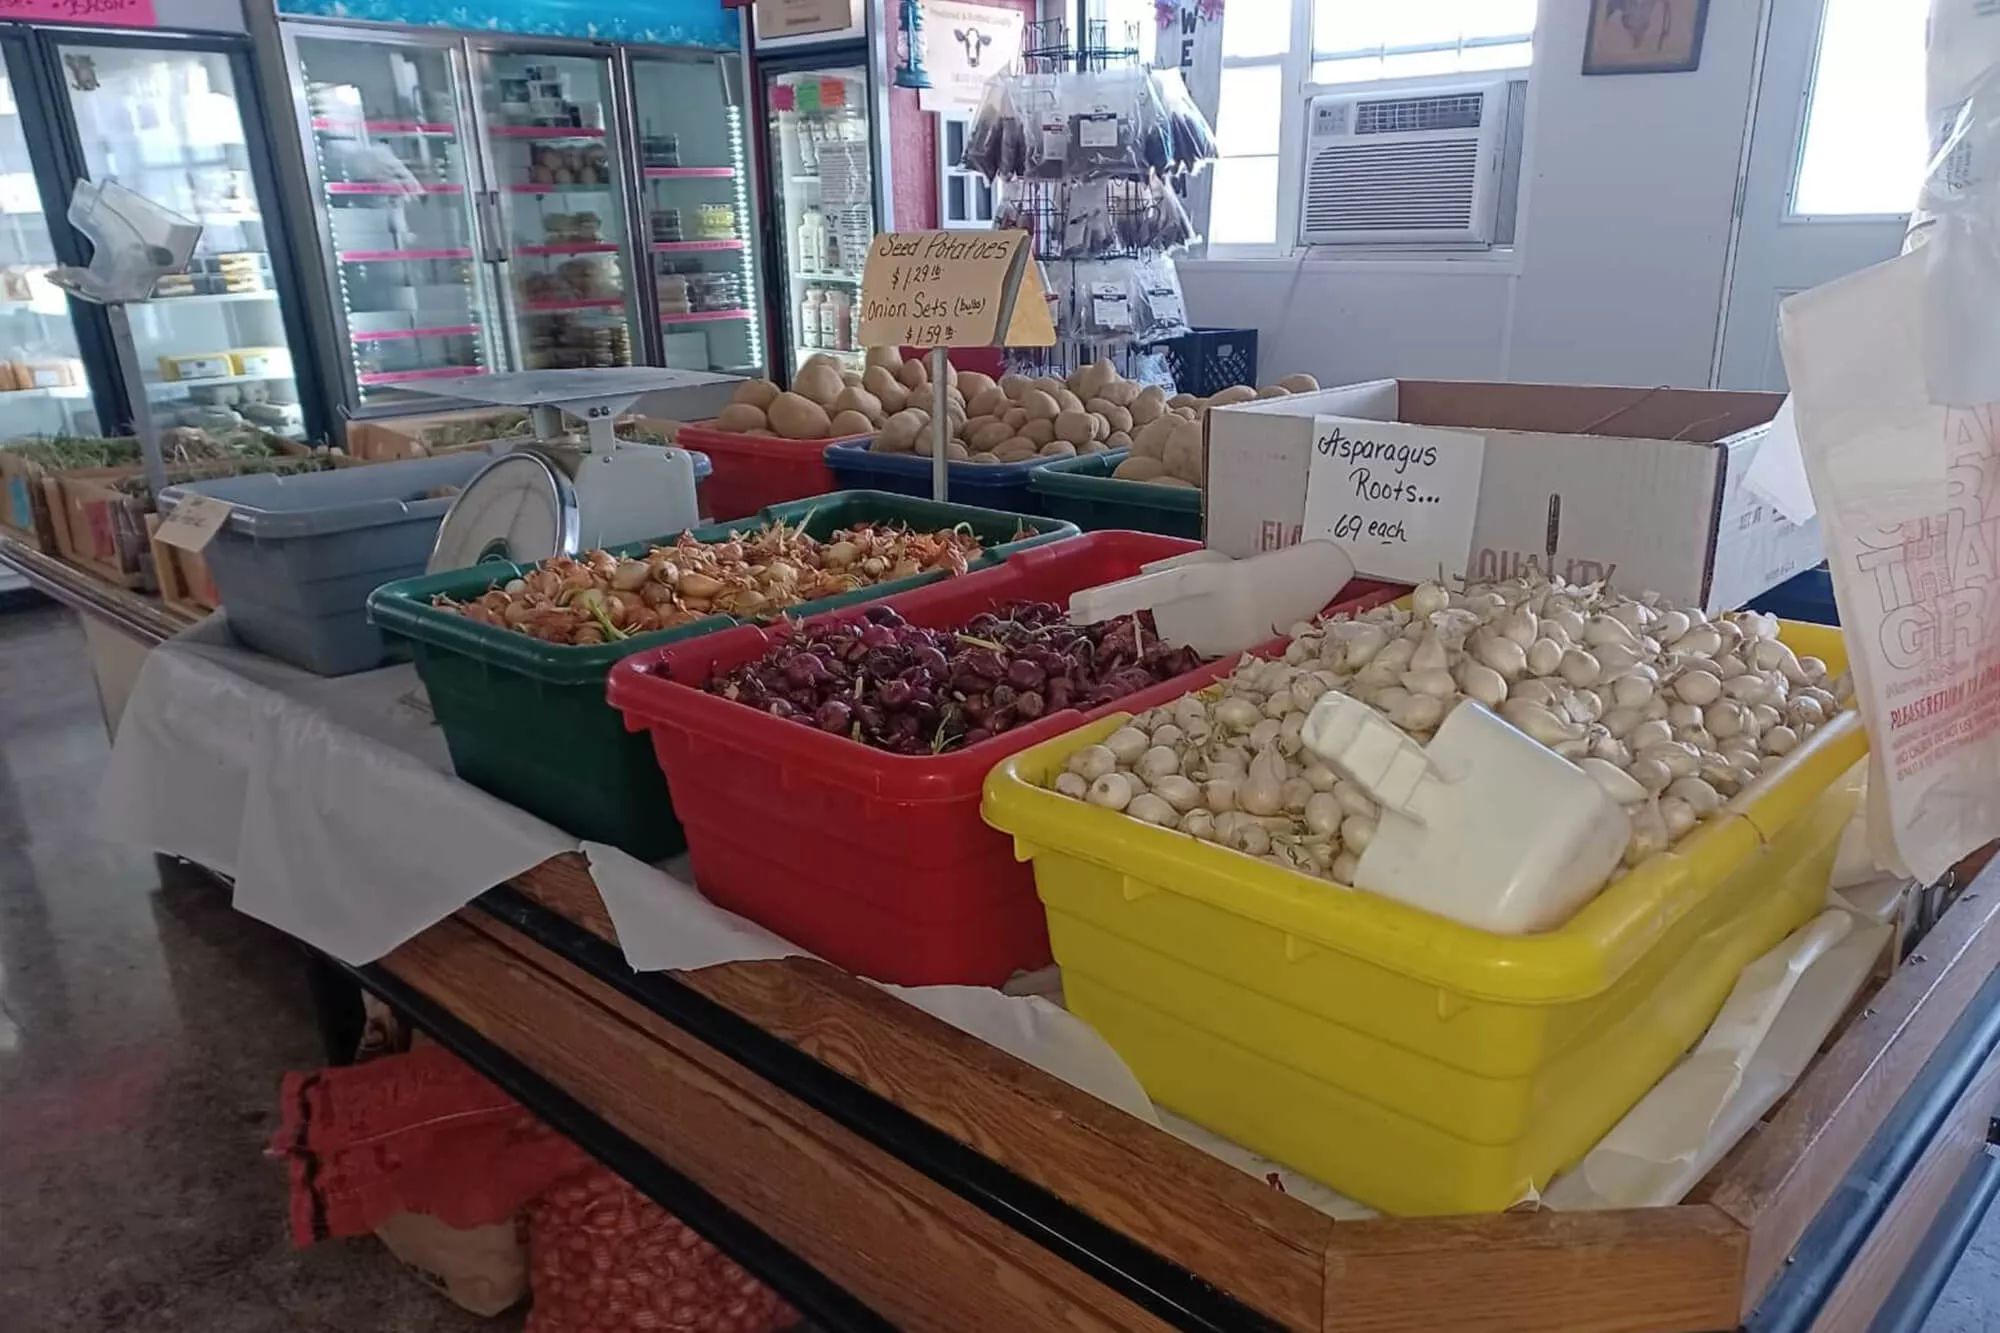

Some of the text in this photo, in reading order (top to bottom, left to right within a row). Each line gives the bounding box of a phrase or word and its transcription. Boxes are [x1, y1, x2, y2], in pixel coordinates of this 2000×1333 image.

[880, 232, 923, 257] Seed
[924, 231, 1010, 260] Potatoes
[912, 291, 948, 318] Sets
[1317, 427, 1437, 474] Asparagus
[1368, 518, 1408, 545] each
